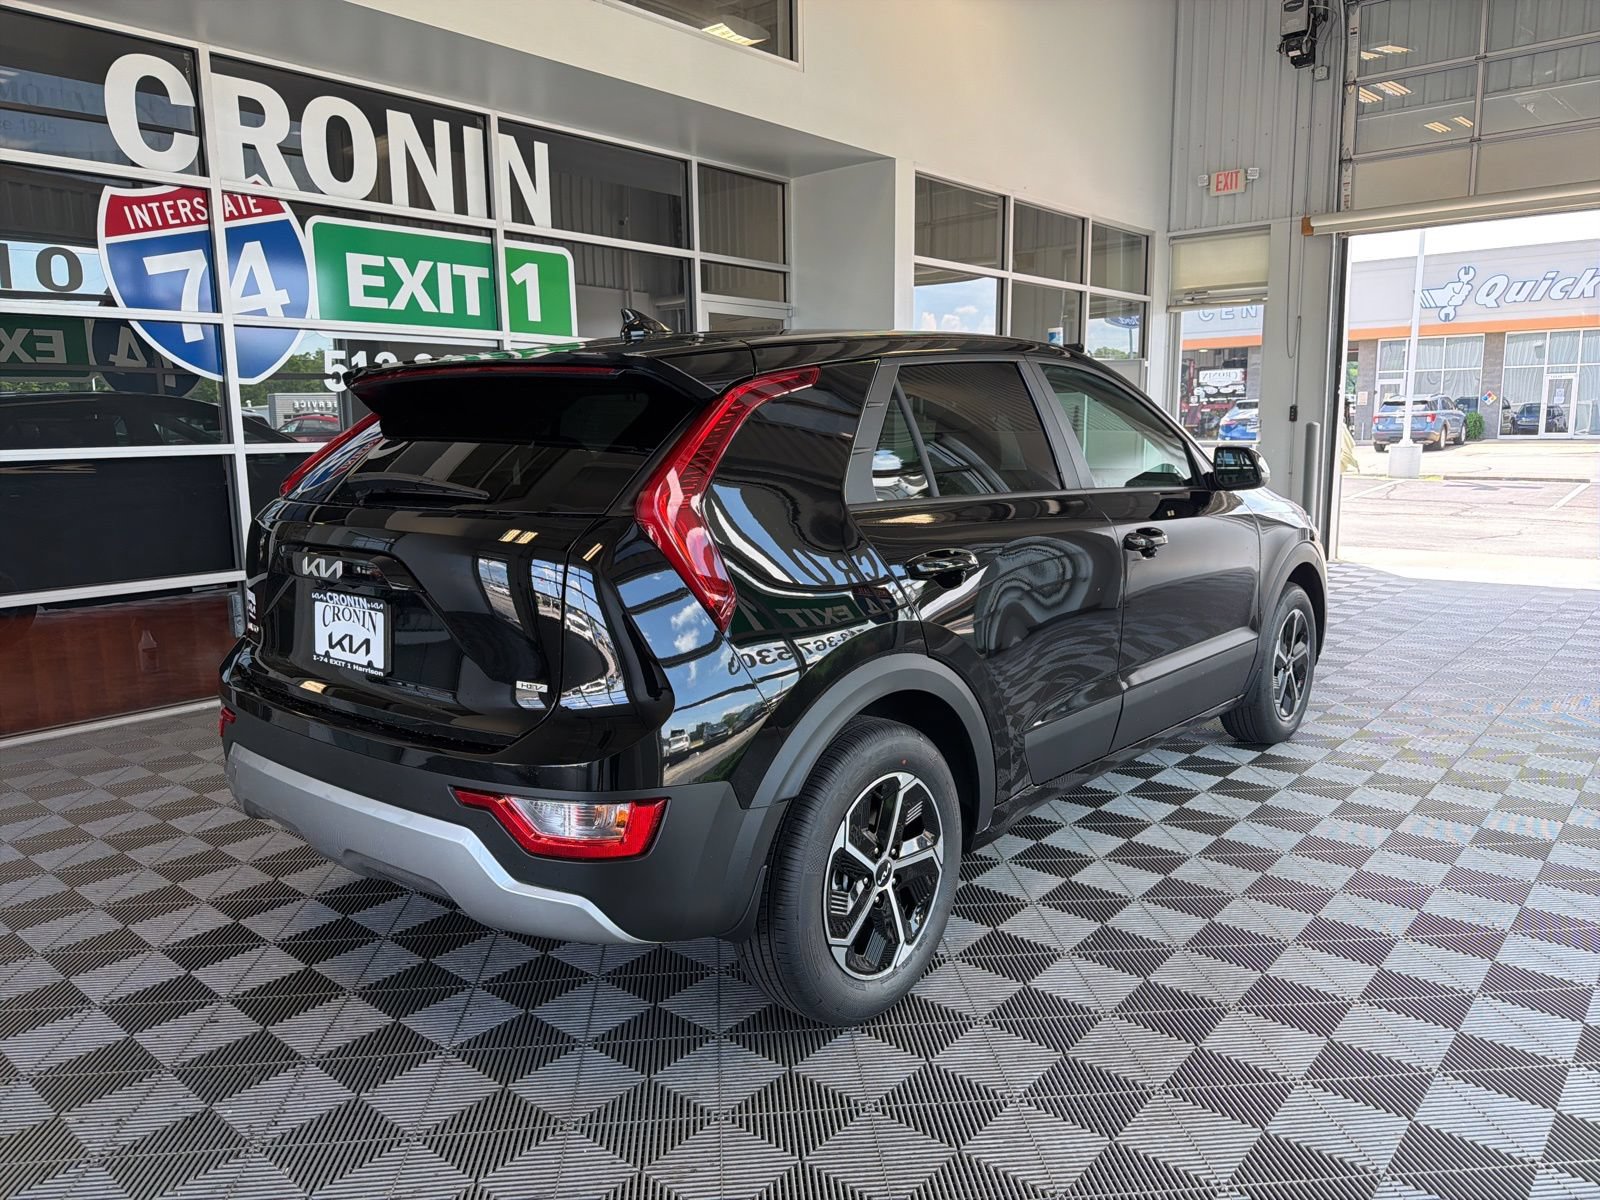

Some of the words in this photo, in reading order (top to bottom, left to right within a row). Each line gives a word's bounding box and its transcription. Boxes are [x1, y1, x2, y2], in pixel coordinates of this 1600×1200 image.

[104, 53, 552, 229] CRONIN
[1215, 171, 1241, 192] EXIT
[124, 194, 263, 230] INTERSATE
[143, 240, 292, 343] 74
[345, 252, 489, 316] EXIT
[510, 263, 541, 322] 1
[1475, 267, 1600, 308] Quick
[326, 592, 368, 609] CRONIN
[322, 604, 378, 636] CRONIN
[329, 658, 346, 668] EXIT
[353, 663, 384, 677] Harrison
